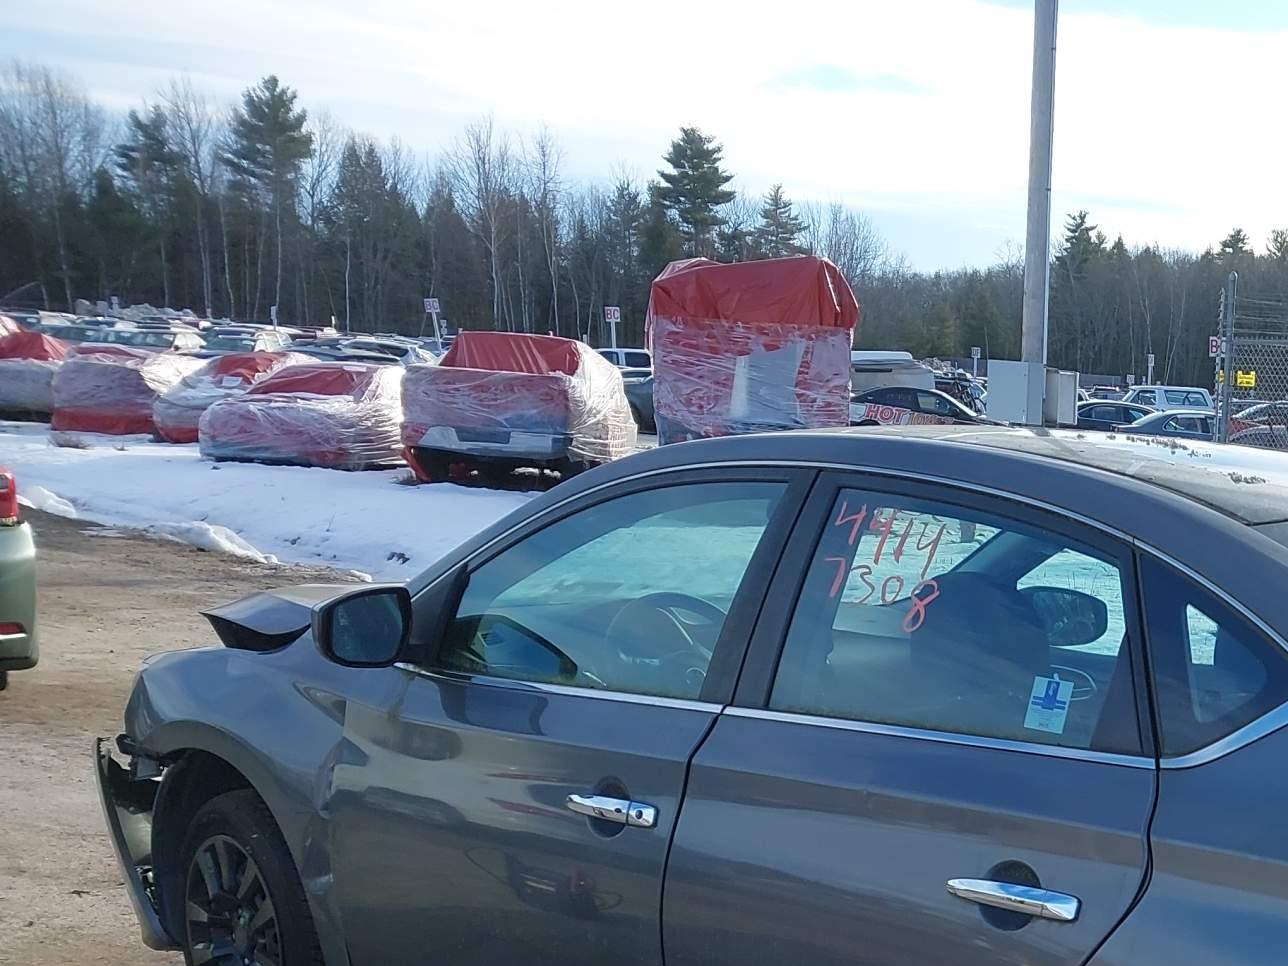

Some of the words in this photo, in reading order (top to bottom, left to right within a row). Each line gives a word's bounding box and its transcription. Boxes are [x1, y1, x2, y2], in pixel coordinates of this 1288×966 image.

[606, 309, 619, 320] BC
[866, 403, 909, 425] HOT
[834, 500, 947, 580] 4414
[824, 556, 940, 633] 7308
